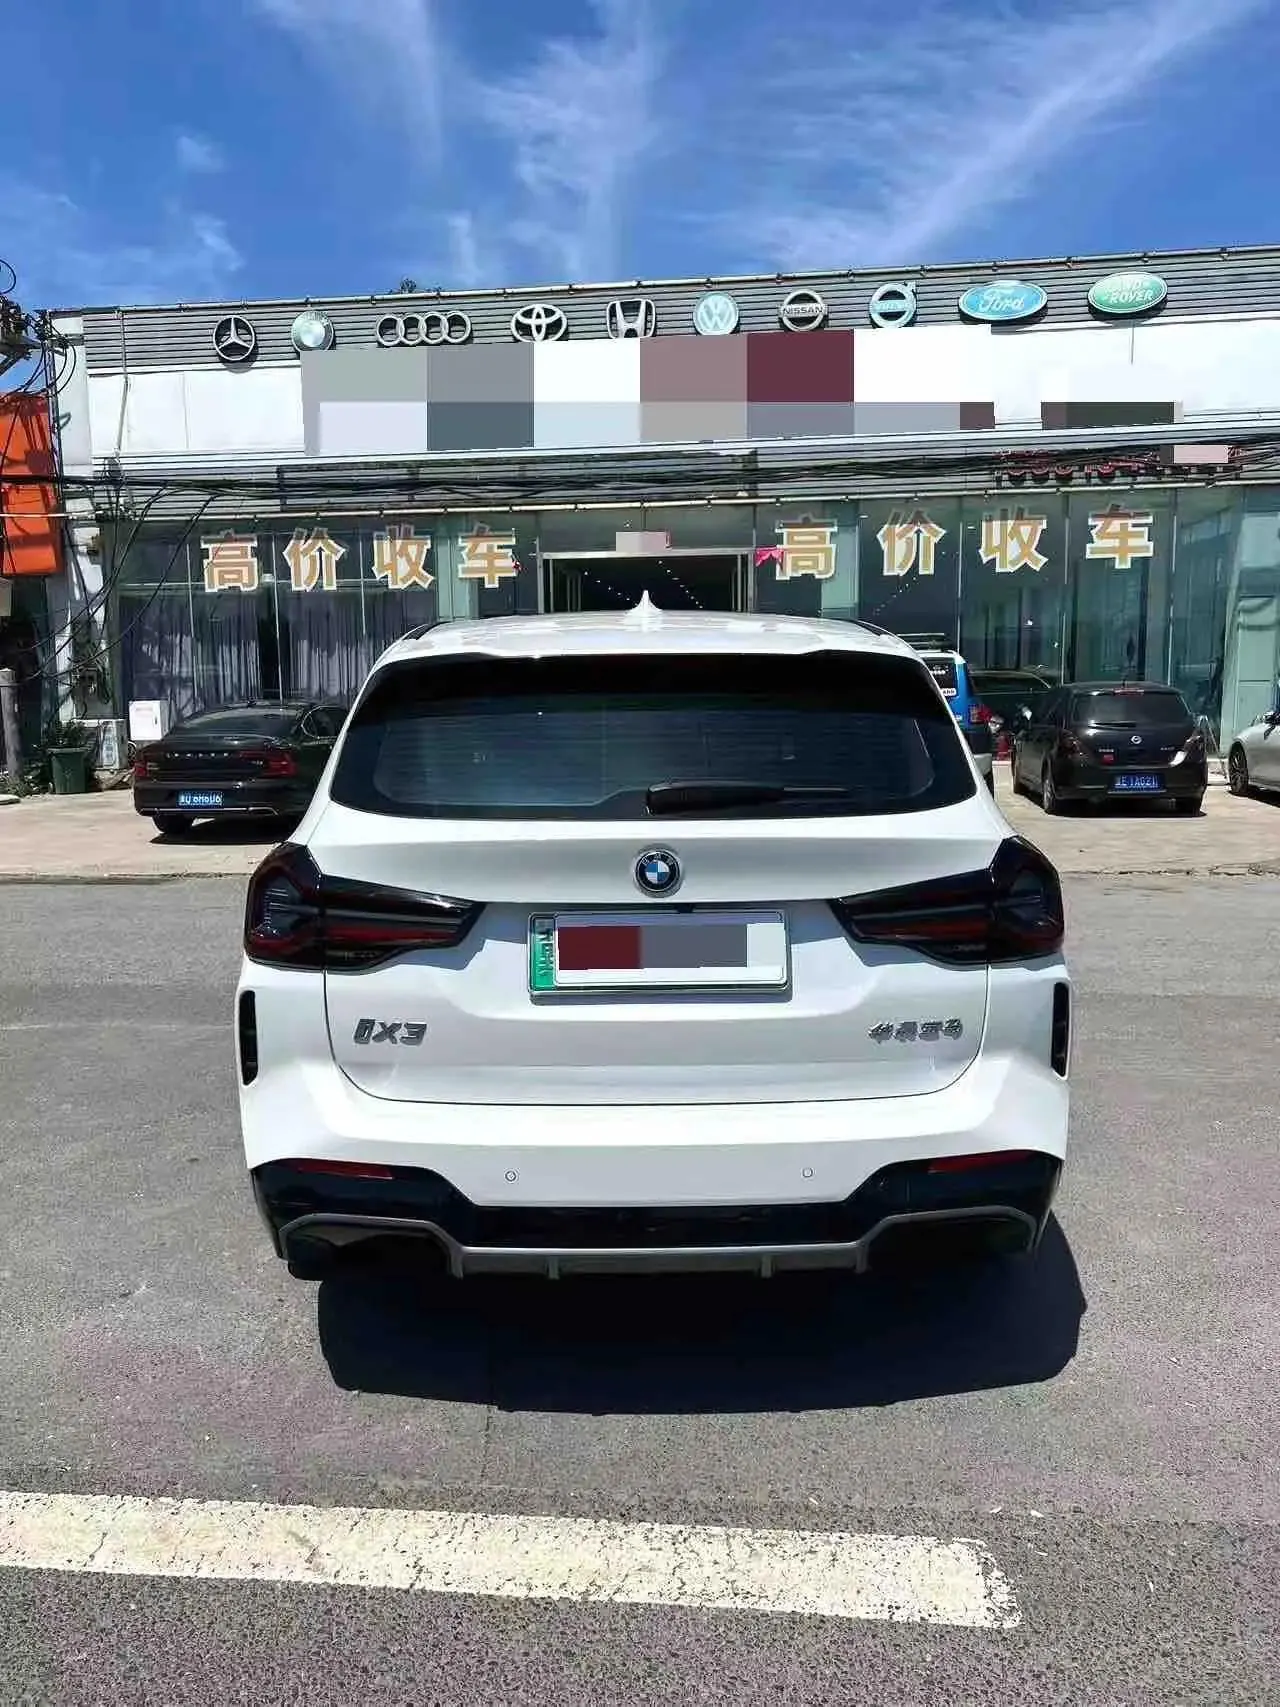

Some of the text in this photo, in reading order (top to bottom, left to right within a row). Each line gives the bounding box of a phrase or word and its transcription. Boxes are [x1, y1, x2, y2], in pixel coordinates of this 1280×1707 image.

[979, 289, 1025, 312] Ford
[1110, 289, 1153, 303] ROVER
[783, 305, 825, 315] NISSAN
[775, 503, 1154, 581] 高价收车
[200, 522, 518, 592] 高价收车
